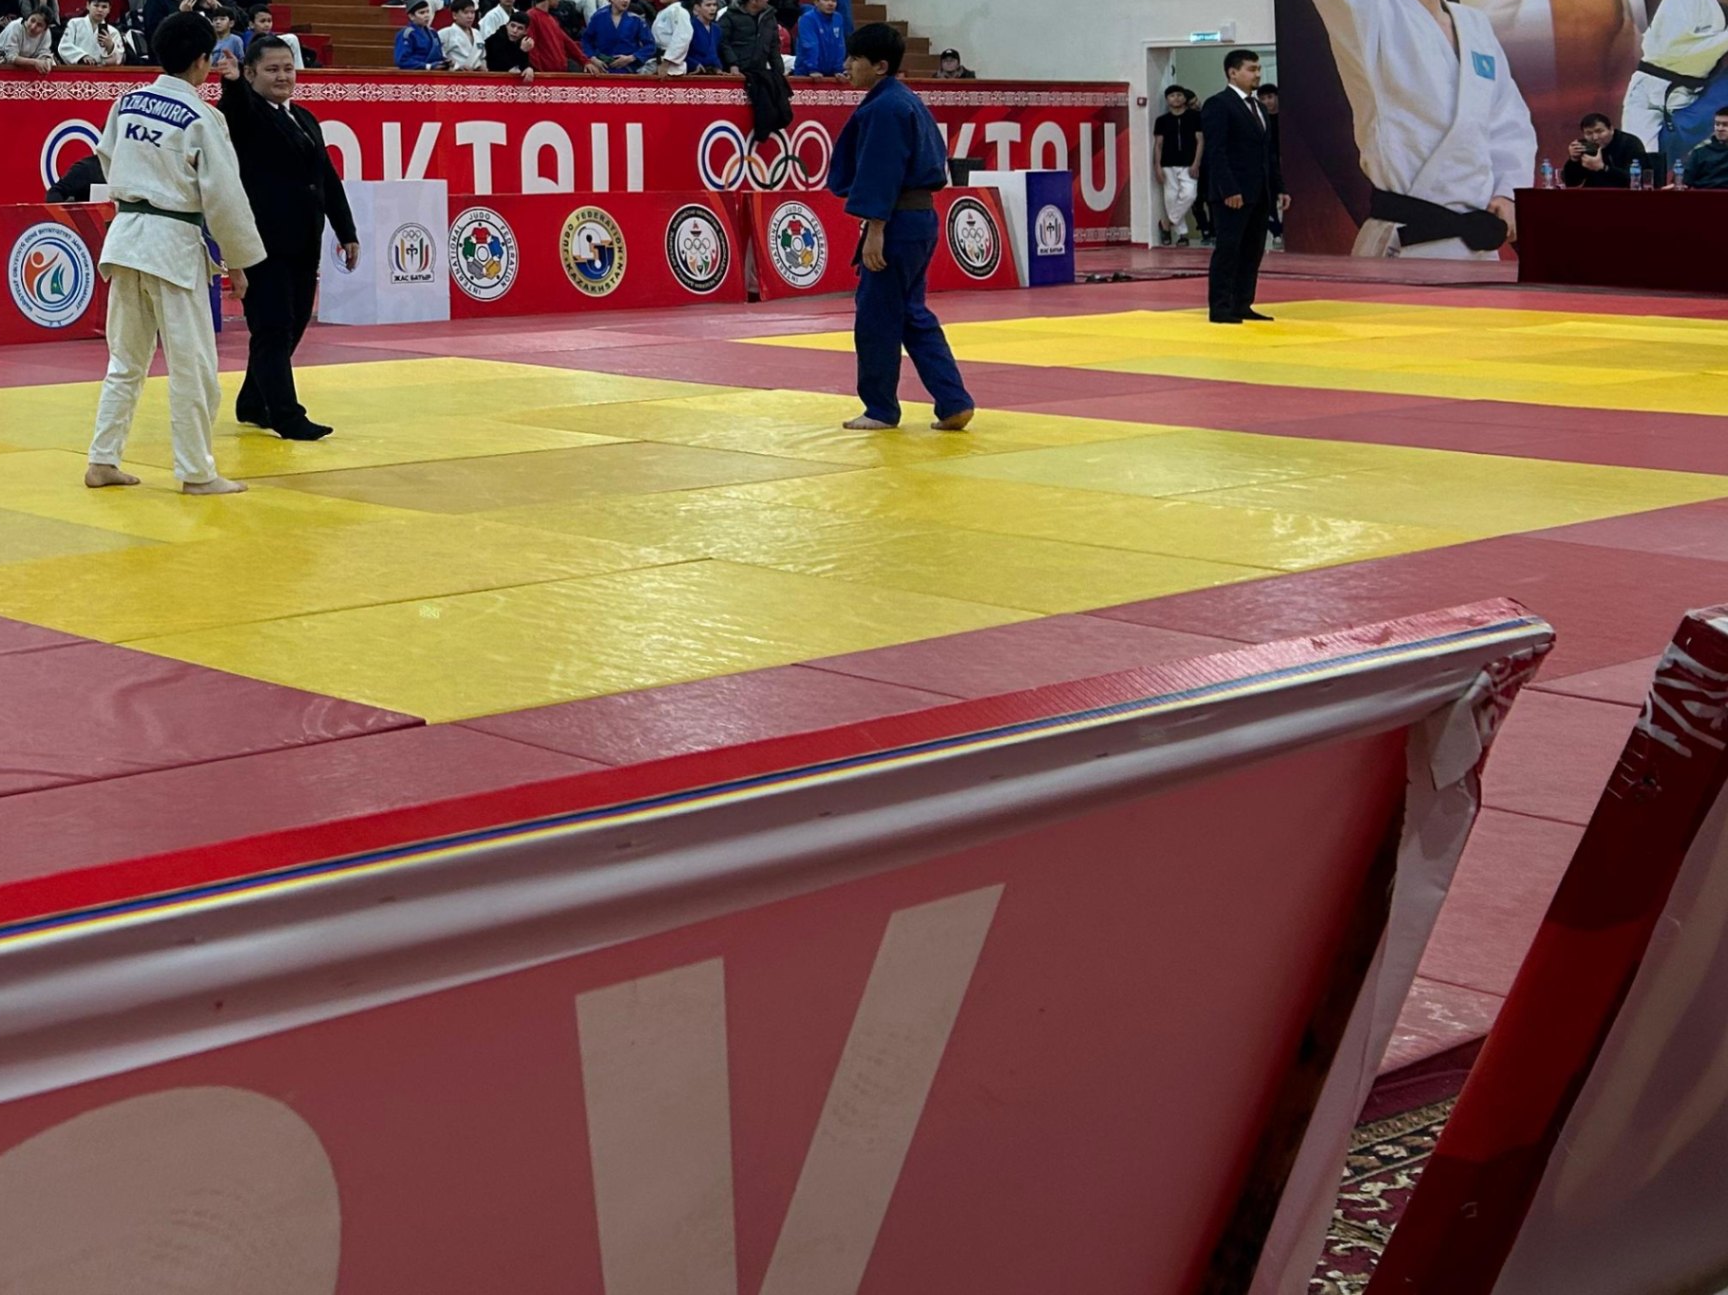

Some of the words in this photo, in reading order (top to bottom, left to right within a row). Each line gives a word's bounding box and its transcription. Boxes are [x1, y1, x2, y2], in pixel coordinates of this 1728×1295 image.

[125, 122, 163, 148] KAZ
[468, 211, 491, 221] JUDO
[499, 224, 515, 289] FEDERATION
[562, 223, 574, 256] JUDO
[575, 210, 623, 254] FEDERATION
[565, 262, 623, 293] KAZAKHSTAN
